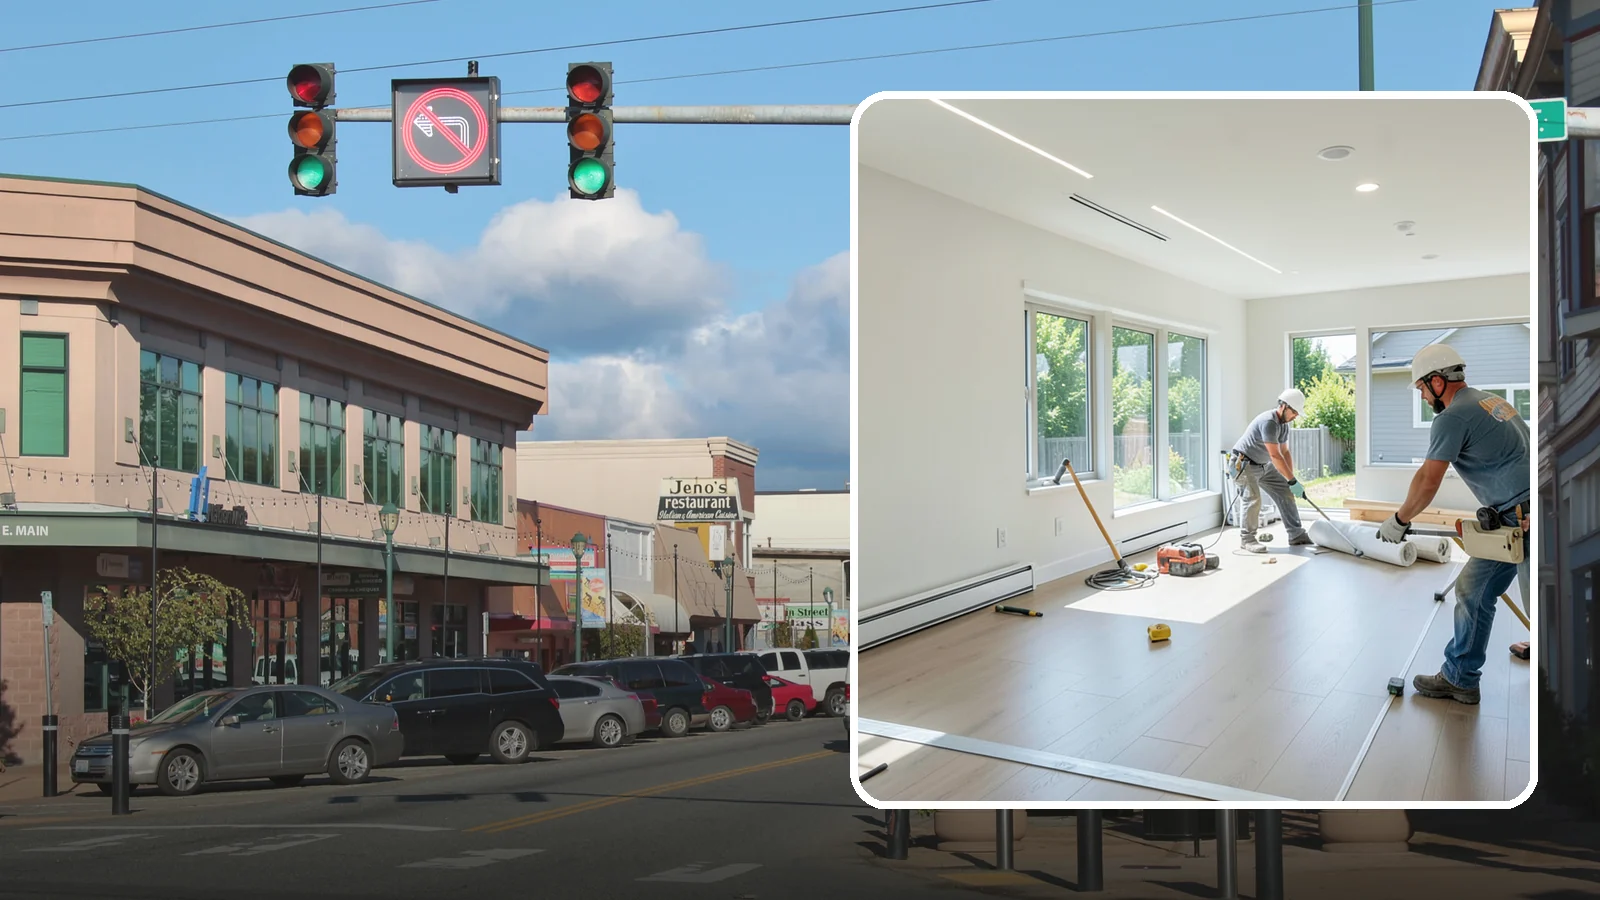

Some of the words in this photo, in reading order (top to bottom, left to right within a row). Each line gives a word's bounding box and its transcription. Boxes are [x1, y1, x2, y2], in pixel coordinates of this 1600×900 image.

[670, 480, 727, 494] Jeno's
[665, 496, 731, 509] restaurant
[658, 510, 682, 519] Italian
[686, 509, 714, 519] American
[715, 509, 737, 519] Cuisine
[2, 525, 13, 536] E.
[15, 525, 49, 536] MAIN
[797, 608, 828, 616] Street
